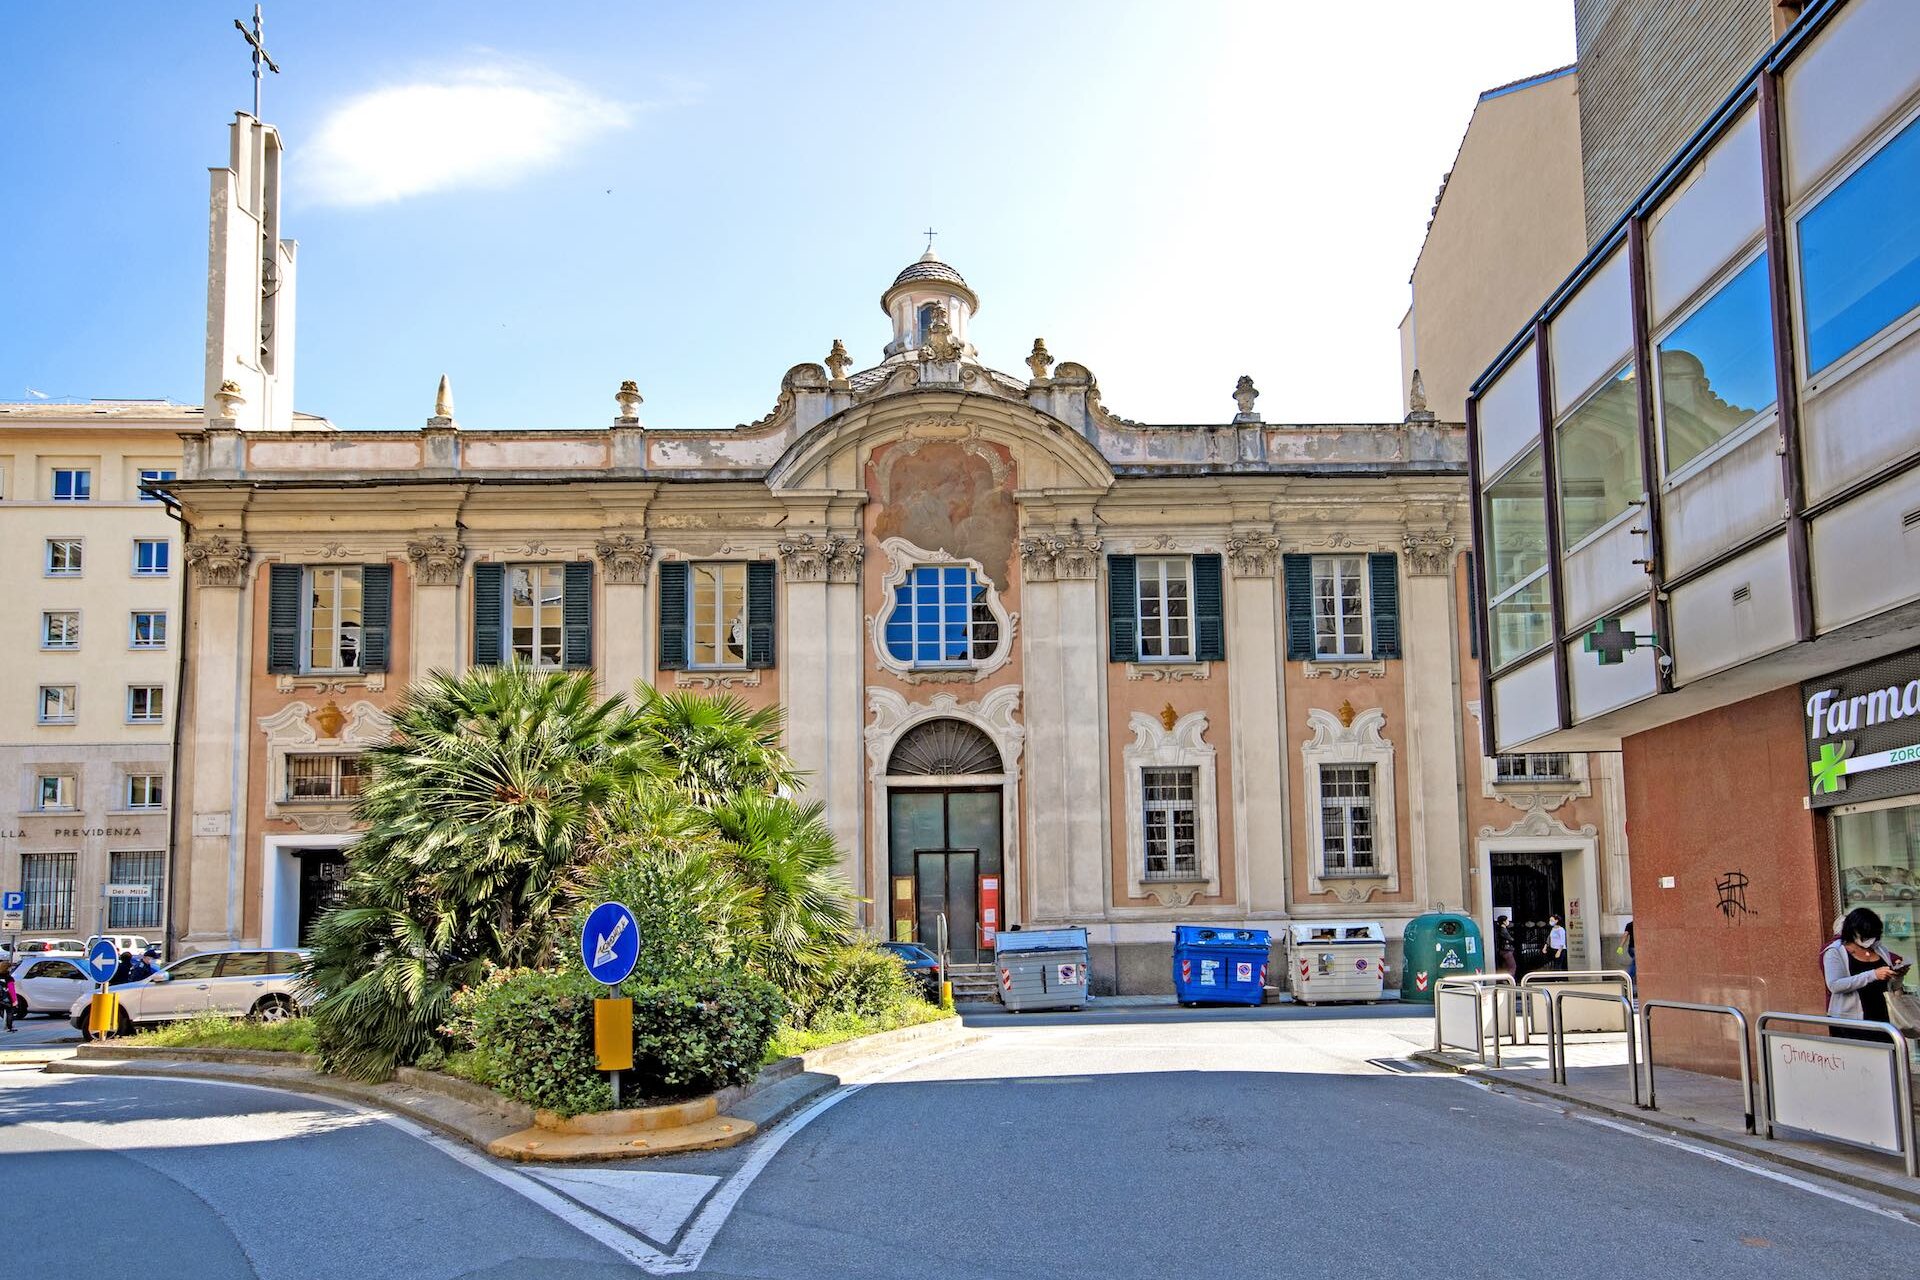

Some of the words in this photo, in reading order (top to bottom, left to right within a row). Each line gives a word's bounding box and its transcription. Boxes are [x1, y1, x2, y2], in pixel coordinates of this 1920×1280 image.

[1806, 679, 1920, 739] Farma
[1, 830, 26, 838] LLA
[55, 828, 142, 837] PREVIDENZA
[8, 893, 22, 909] P
